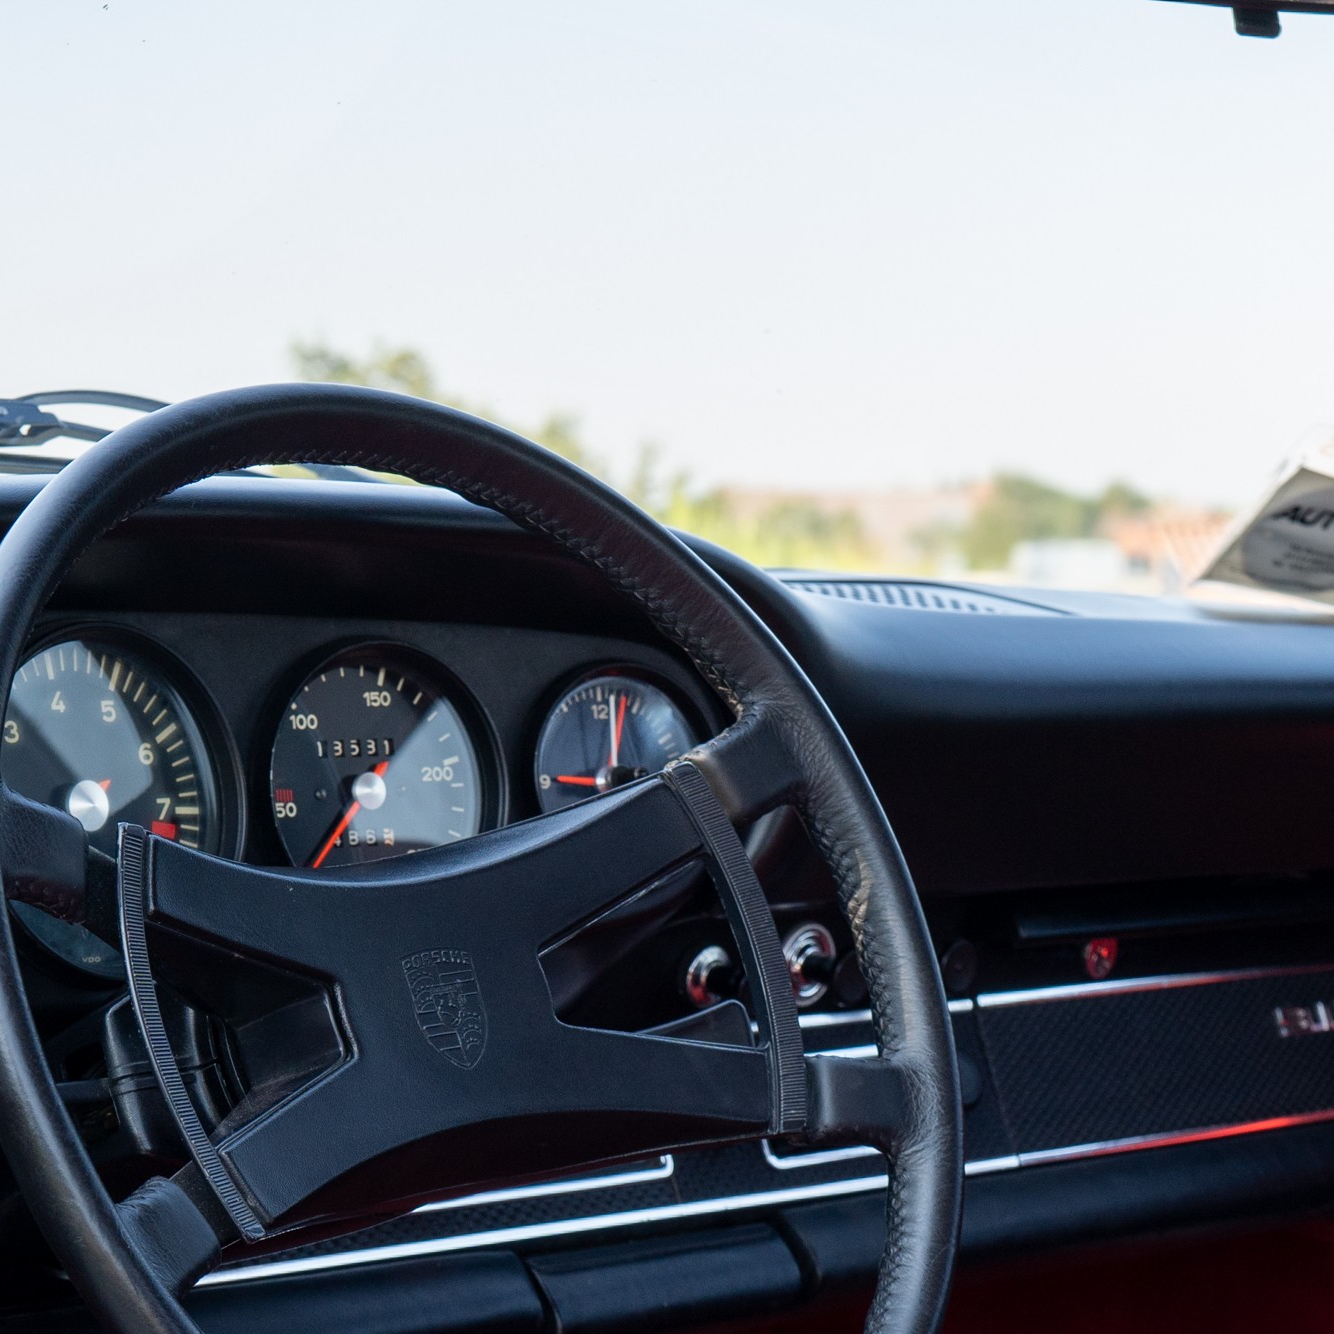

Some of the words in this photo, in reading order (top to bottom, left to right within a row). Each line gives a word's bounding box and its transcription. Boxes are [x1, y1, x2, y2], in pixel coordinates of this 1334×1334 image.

[50, 691, 66, 713] 4
[363, 691, 391, 707] 150
[100, 700, 117, 722] 5
[591, 704, 609, 720] 12
[289, 714, 318, 730] 100
[3, 720, 20, 744] 3
[138, 742, 155, 765] 6
[421, 767, 454, 782] 200
[539, 774, 552, 790] 9
[156, 797, 171, 820] 7
[275, 802, 297, 818] 50
[81, 955, 102, 963] VDO
[402, 950, 471, 973] PORSCHE
